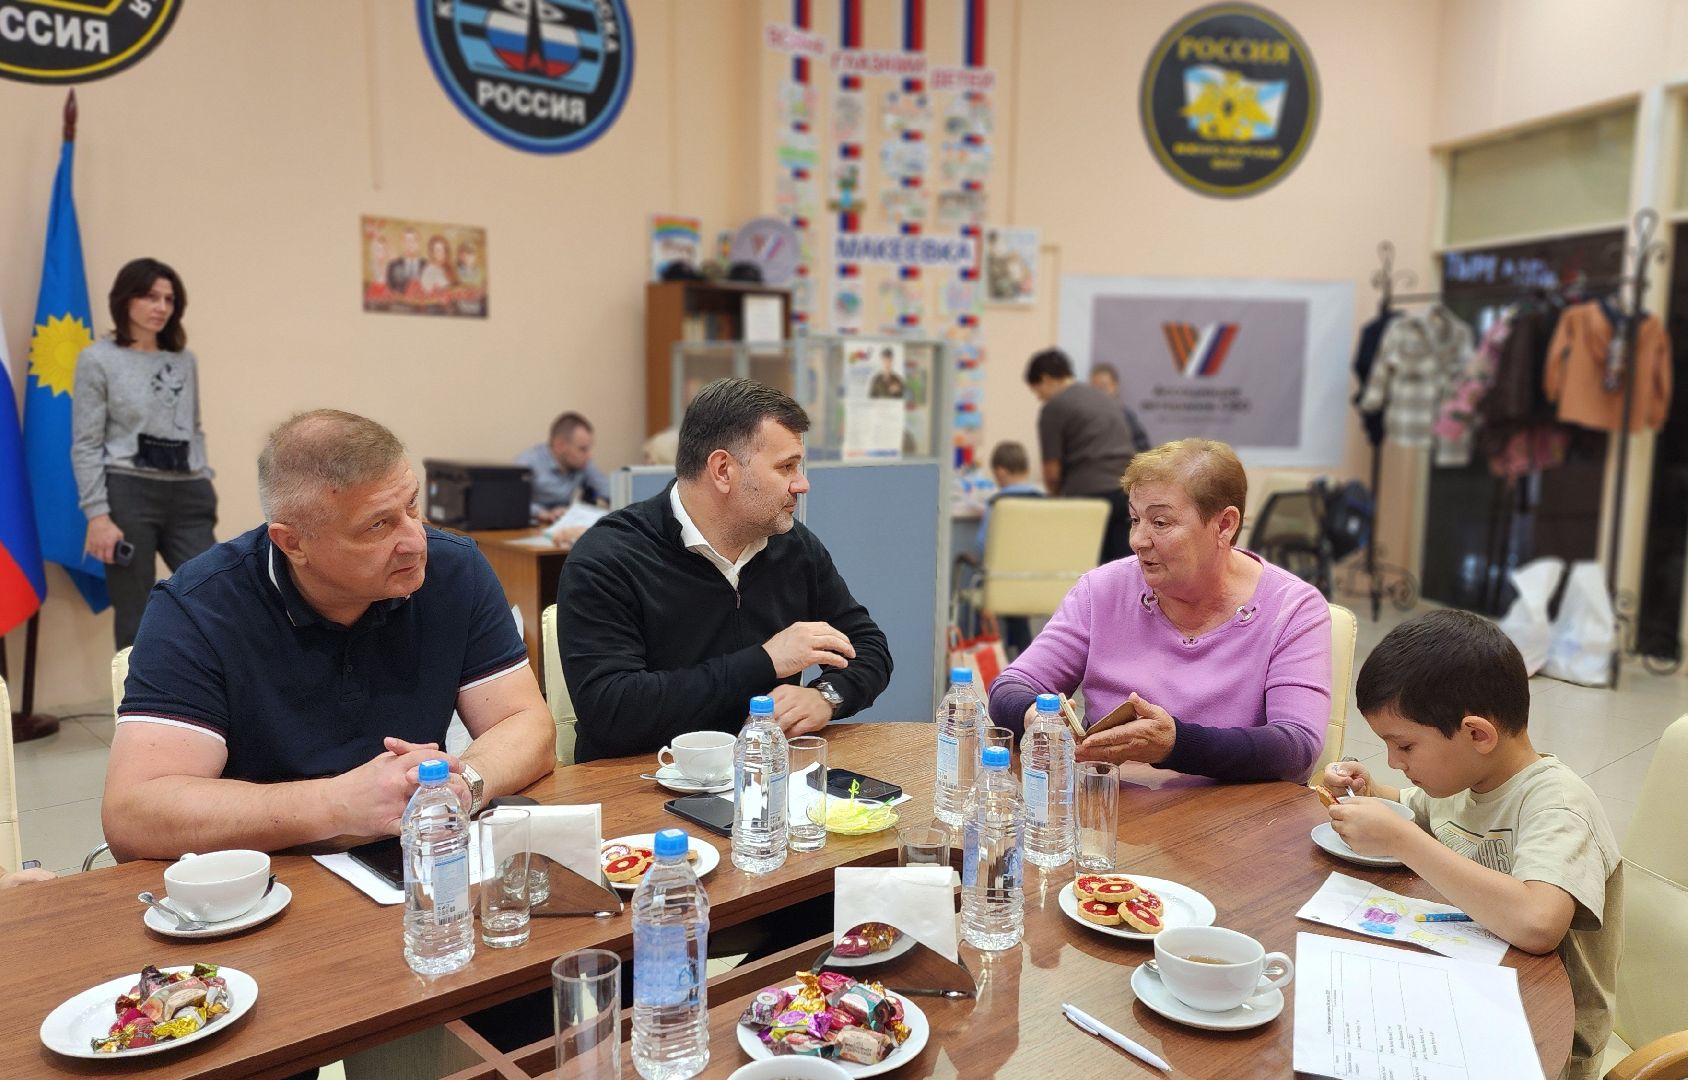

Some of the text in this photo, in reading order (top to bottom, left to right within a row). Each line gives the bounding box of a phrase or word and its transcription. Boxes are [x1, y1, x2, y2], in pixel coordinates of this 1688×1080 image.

[1178, 36, 1290, 65] РОССИЯ
[476, 79, 587, 125] РОССИЯ
[837, 236, 970, 265] МАКЕЕВКА
